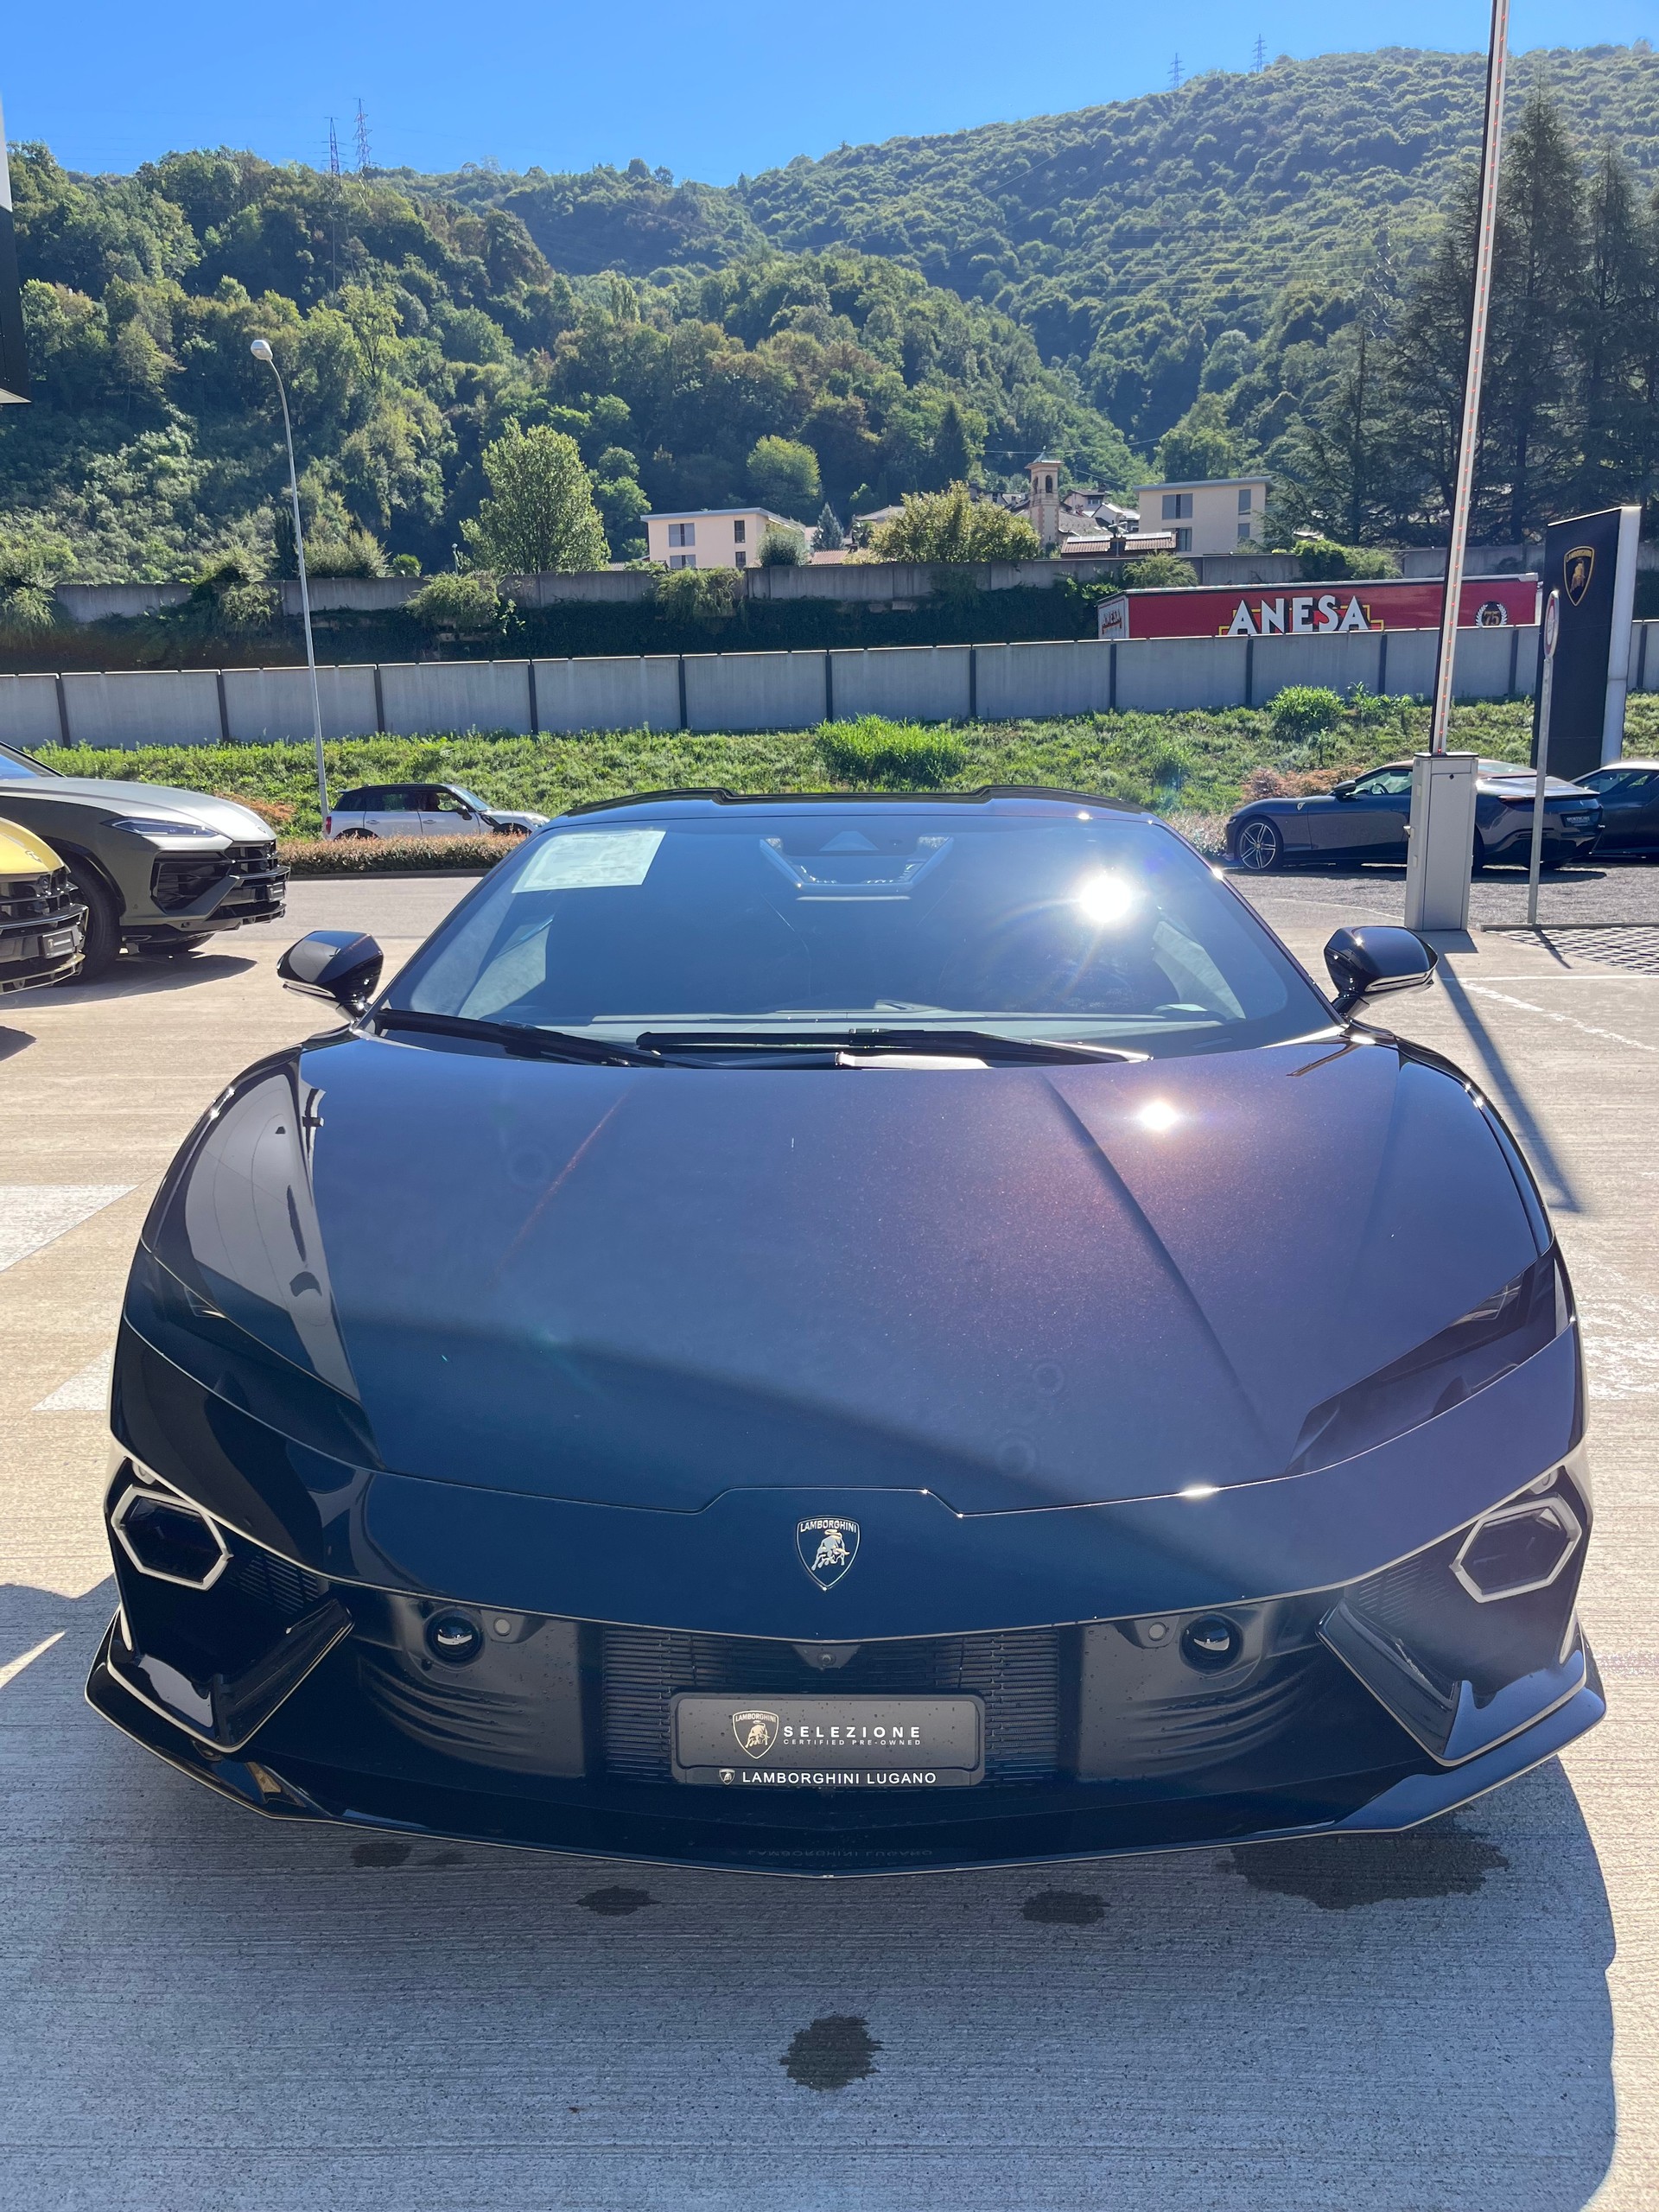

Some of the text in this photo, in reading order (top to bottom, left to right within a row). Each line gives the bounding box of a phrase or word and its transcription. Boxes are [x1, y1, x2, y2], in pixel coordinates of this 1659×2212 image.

[1227, 594, 1369, 636] ANESA
[1483, 610, 1500, 626] 75
[800, 1520, 856, 1533] LAMBORGHINI
[735, 1713, 776, 1722] LAMBORGHINI
[784, 1726, 920, 1738] SELEZIONE
[742, 1771, 937, 1784] LAMBORGHINI LUGANO
